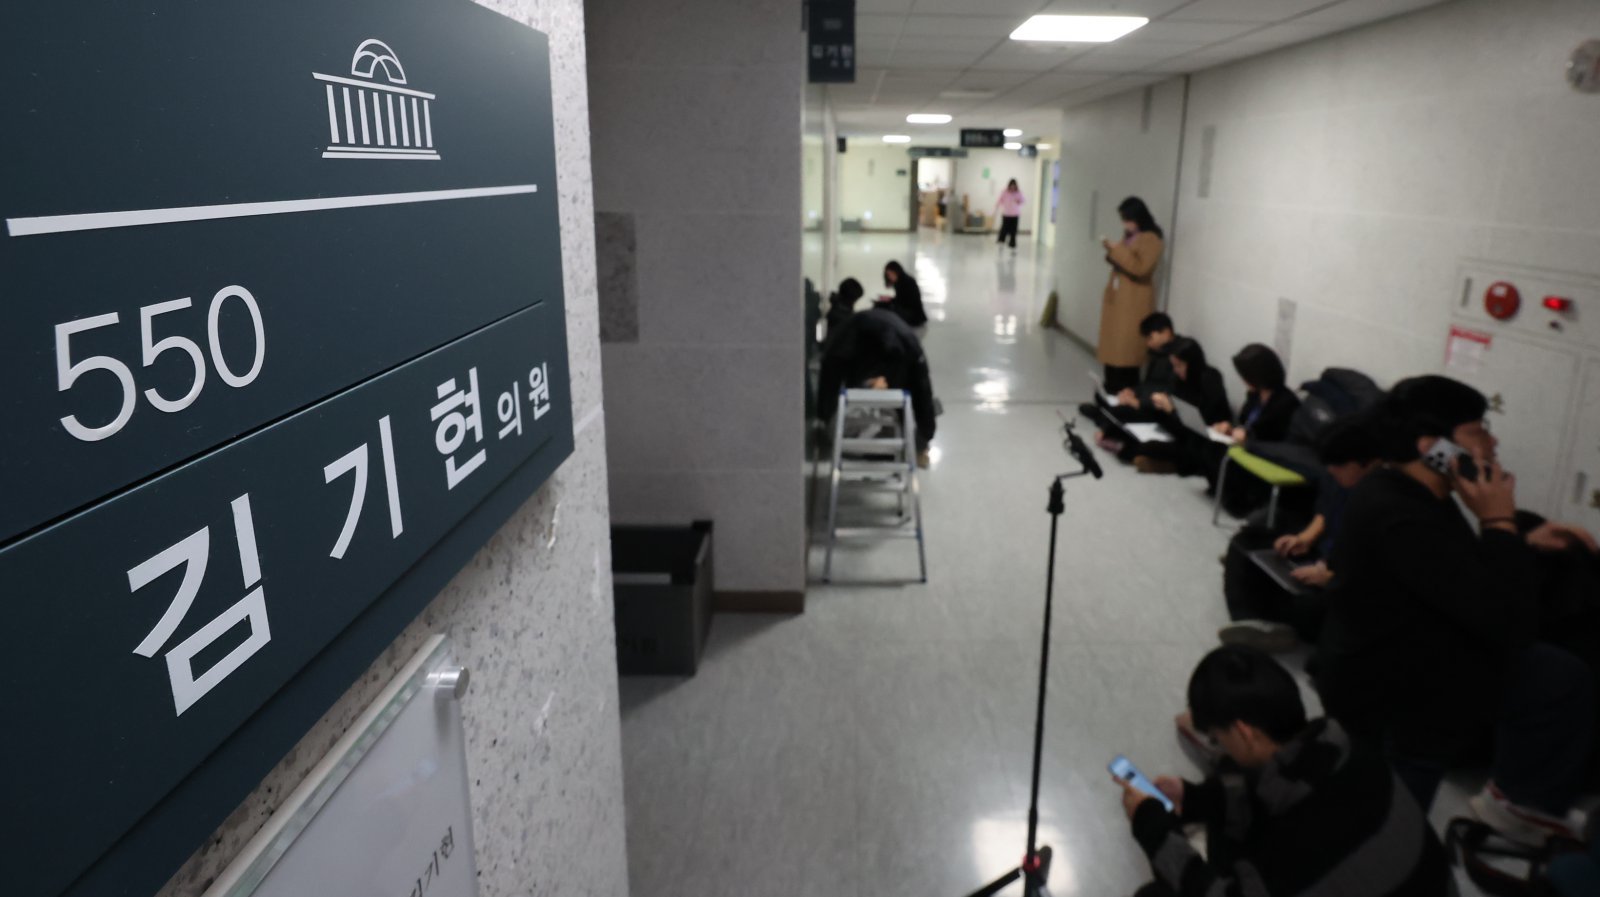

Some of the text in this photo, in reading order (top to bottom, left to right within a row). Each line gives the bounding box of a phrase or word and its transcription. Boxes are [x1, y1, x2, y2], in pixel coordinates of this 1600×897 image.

[54, 284, 266, 442] 550
[126, 362, 550, 717] 김기현 의원
